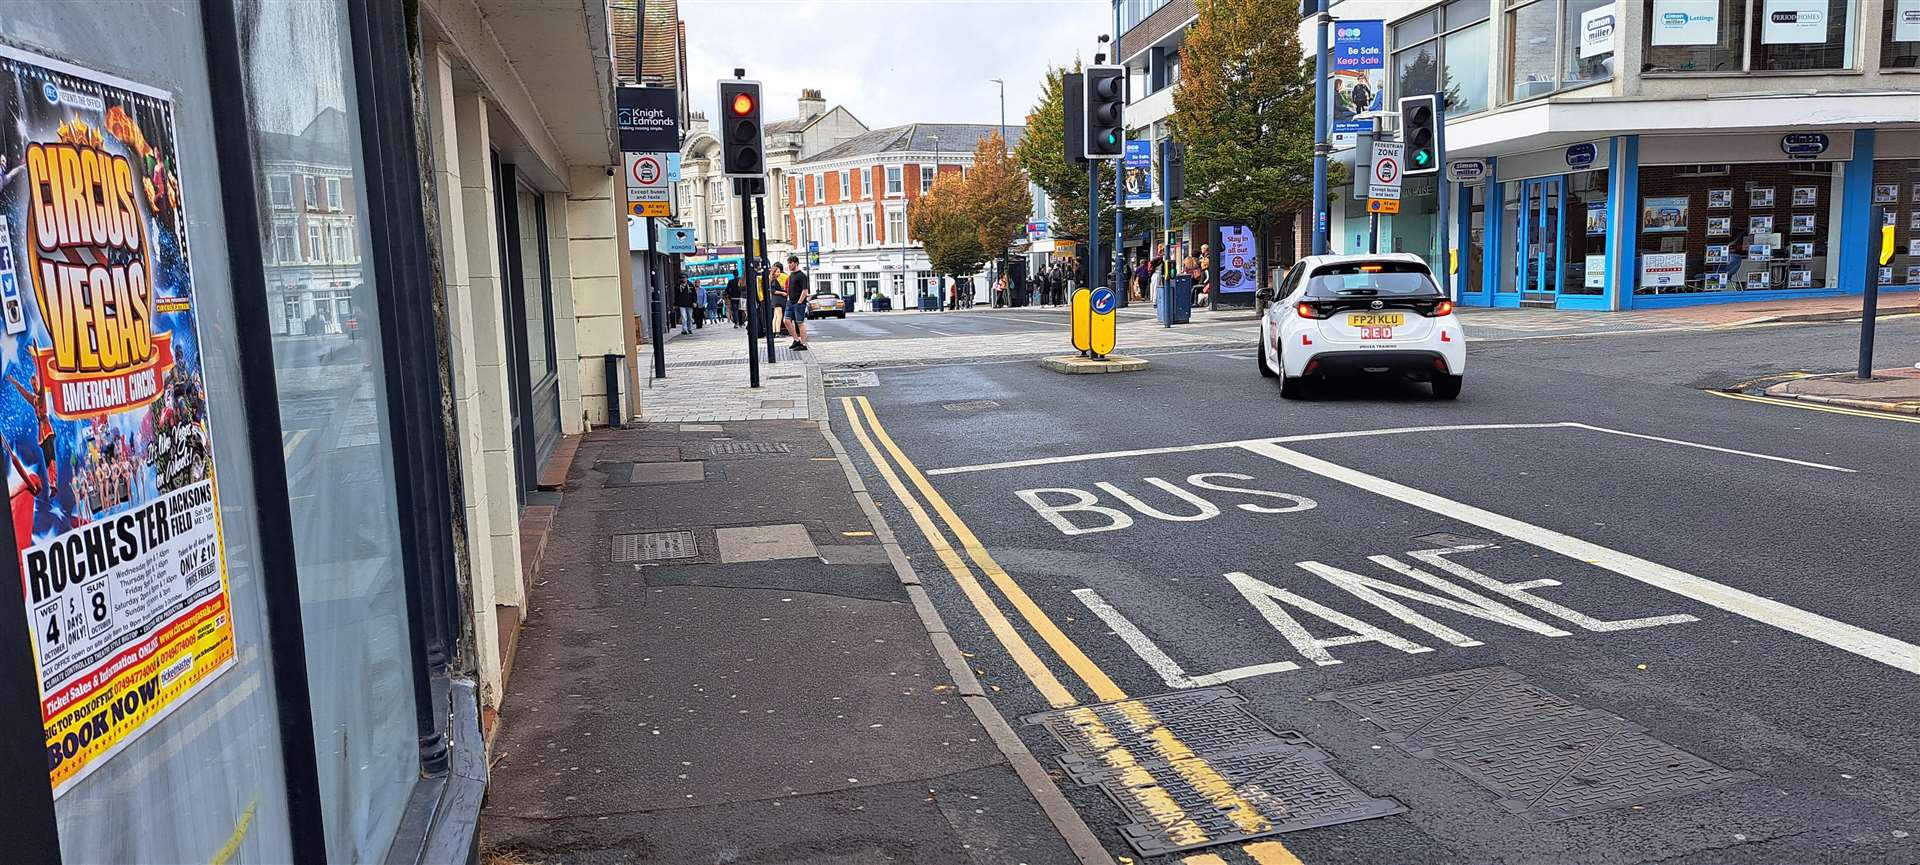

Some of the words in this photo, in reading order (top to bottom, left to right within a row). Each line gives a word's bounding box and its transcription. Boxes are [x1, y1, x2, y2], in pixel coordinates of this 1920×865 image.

[1589, 17, 1611, 29] simon
[1589, 28, 1610, 40] miller
[1348, 47, 1359, 55] Be
[1360, 46, 1382, 55] Safe.
[1337, 57, 1359, 66] Keep
[1360, 56, 1382, 65] Safe.
[632, 109, 664, 119] Knight
[632, 117, 675, 126] Edmonds
[1377, 149, 1399, 157] ZONE
[26, 144, 140, 251] CIRCUS
[631, 189, 649, 197] Except
[40, 258, 152, 372] VEGAS
[1353, 315, 1376, 324] FP21
[1377, 315, 1398, 323] KLU
[1302, 335, 1312, 345] L
[1361, 328, 1392, 338] RED
[1441, 331, 1451, 342] L
[62, 379, 127, 413] AMERICAN
[129, 367, 157, 401] CIRCUS
[172, 421, 192, 455] Vegas
[168, 483, 212, 517] JACKSONS
[1015, 473, 1319, 535] BUS
[195, 508, 204, 518] Sat
[170, 511, 193, 538] FIELD
[27, 499, 170, 604] ROCHESTER
[179, 549, 199, 577] ONLY
[200, 542, 216, 563] £10
[115, 562, 146, 579] Wednesday
[86, 581, 106, 594] SUN
[120, 573, 145, 589] Thursday
[186, 571, 198, 589] PRICE
[125, 584, 143, 597] Friday
[40, 602, 59, 617] WED
[69, 597, 75, 615] 5
[91, 591, 107, 623] 8
[114, 597, 139, 612] Saturday
[124, 604, 146, 618] Sunday
[67, 613, 83, 632] DAYS
[1072, 544, 1700, 689] LANE
[46, 613, 61, 646] 4
[67, 624, 87, 646] ONLY!
[90, 618, 111, 635] OCTOBER
[42, 667, 54, 678] BOX
[54, 656, 70, 670] OFFICE
[71, 648, 85, 661] open
[86, 645, 94, 653] on
[94, 638, 103, 649] site
[123, 624, 129, 632] to
[43, 642, 66, 661] OCTOBER
[45, 671, 65, 689] CLIMATE
[64, 655, 95, 677] CONTROLLED
[161, 656, 192, 683] ticketmaster
[47, 692, 70, 716] Ticket
[69, 681, 92, 702] Sales
[92, 675, 99, 688] &
[99, 653, 138, 685] Information
[57, 713, 73, 733] TOP
[74, 703, 91, 722] BOX
[90, 687, 114, 711] OFFICE
[47, 709, 110, 773] BOOK
[110, 675, 161, 727] NOW!
